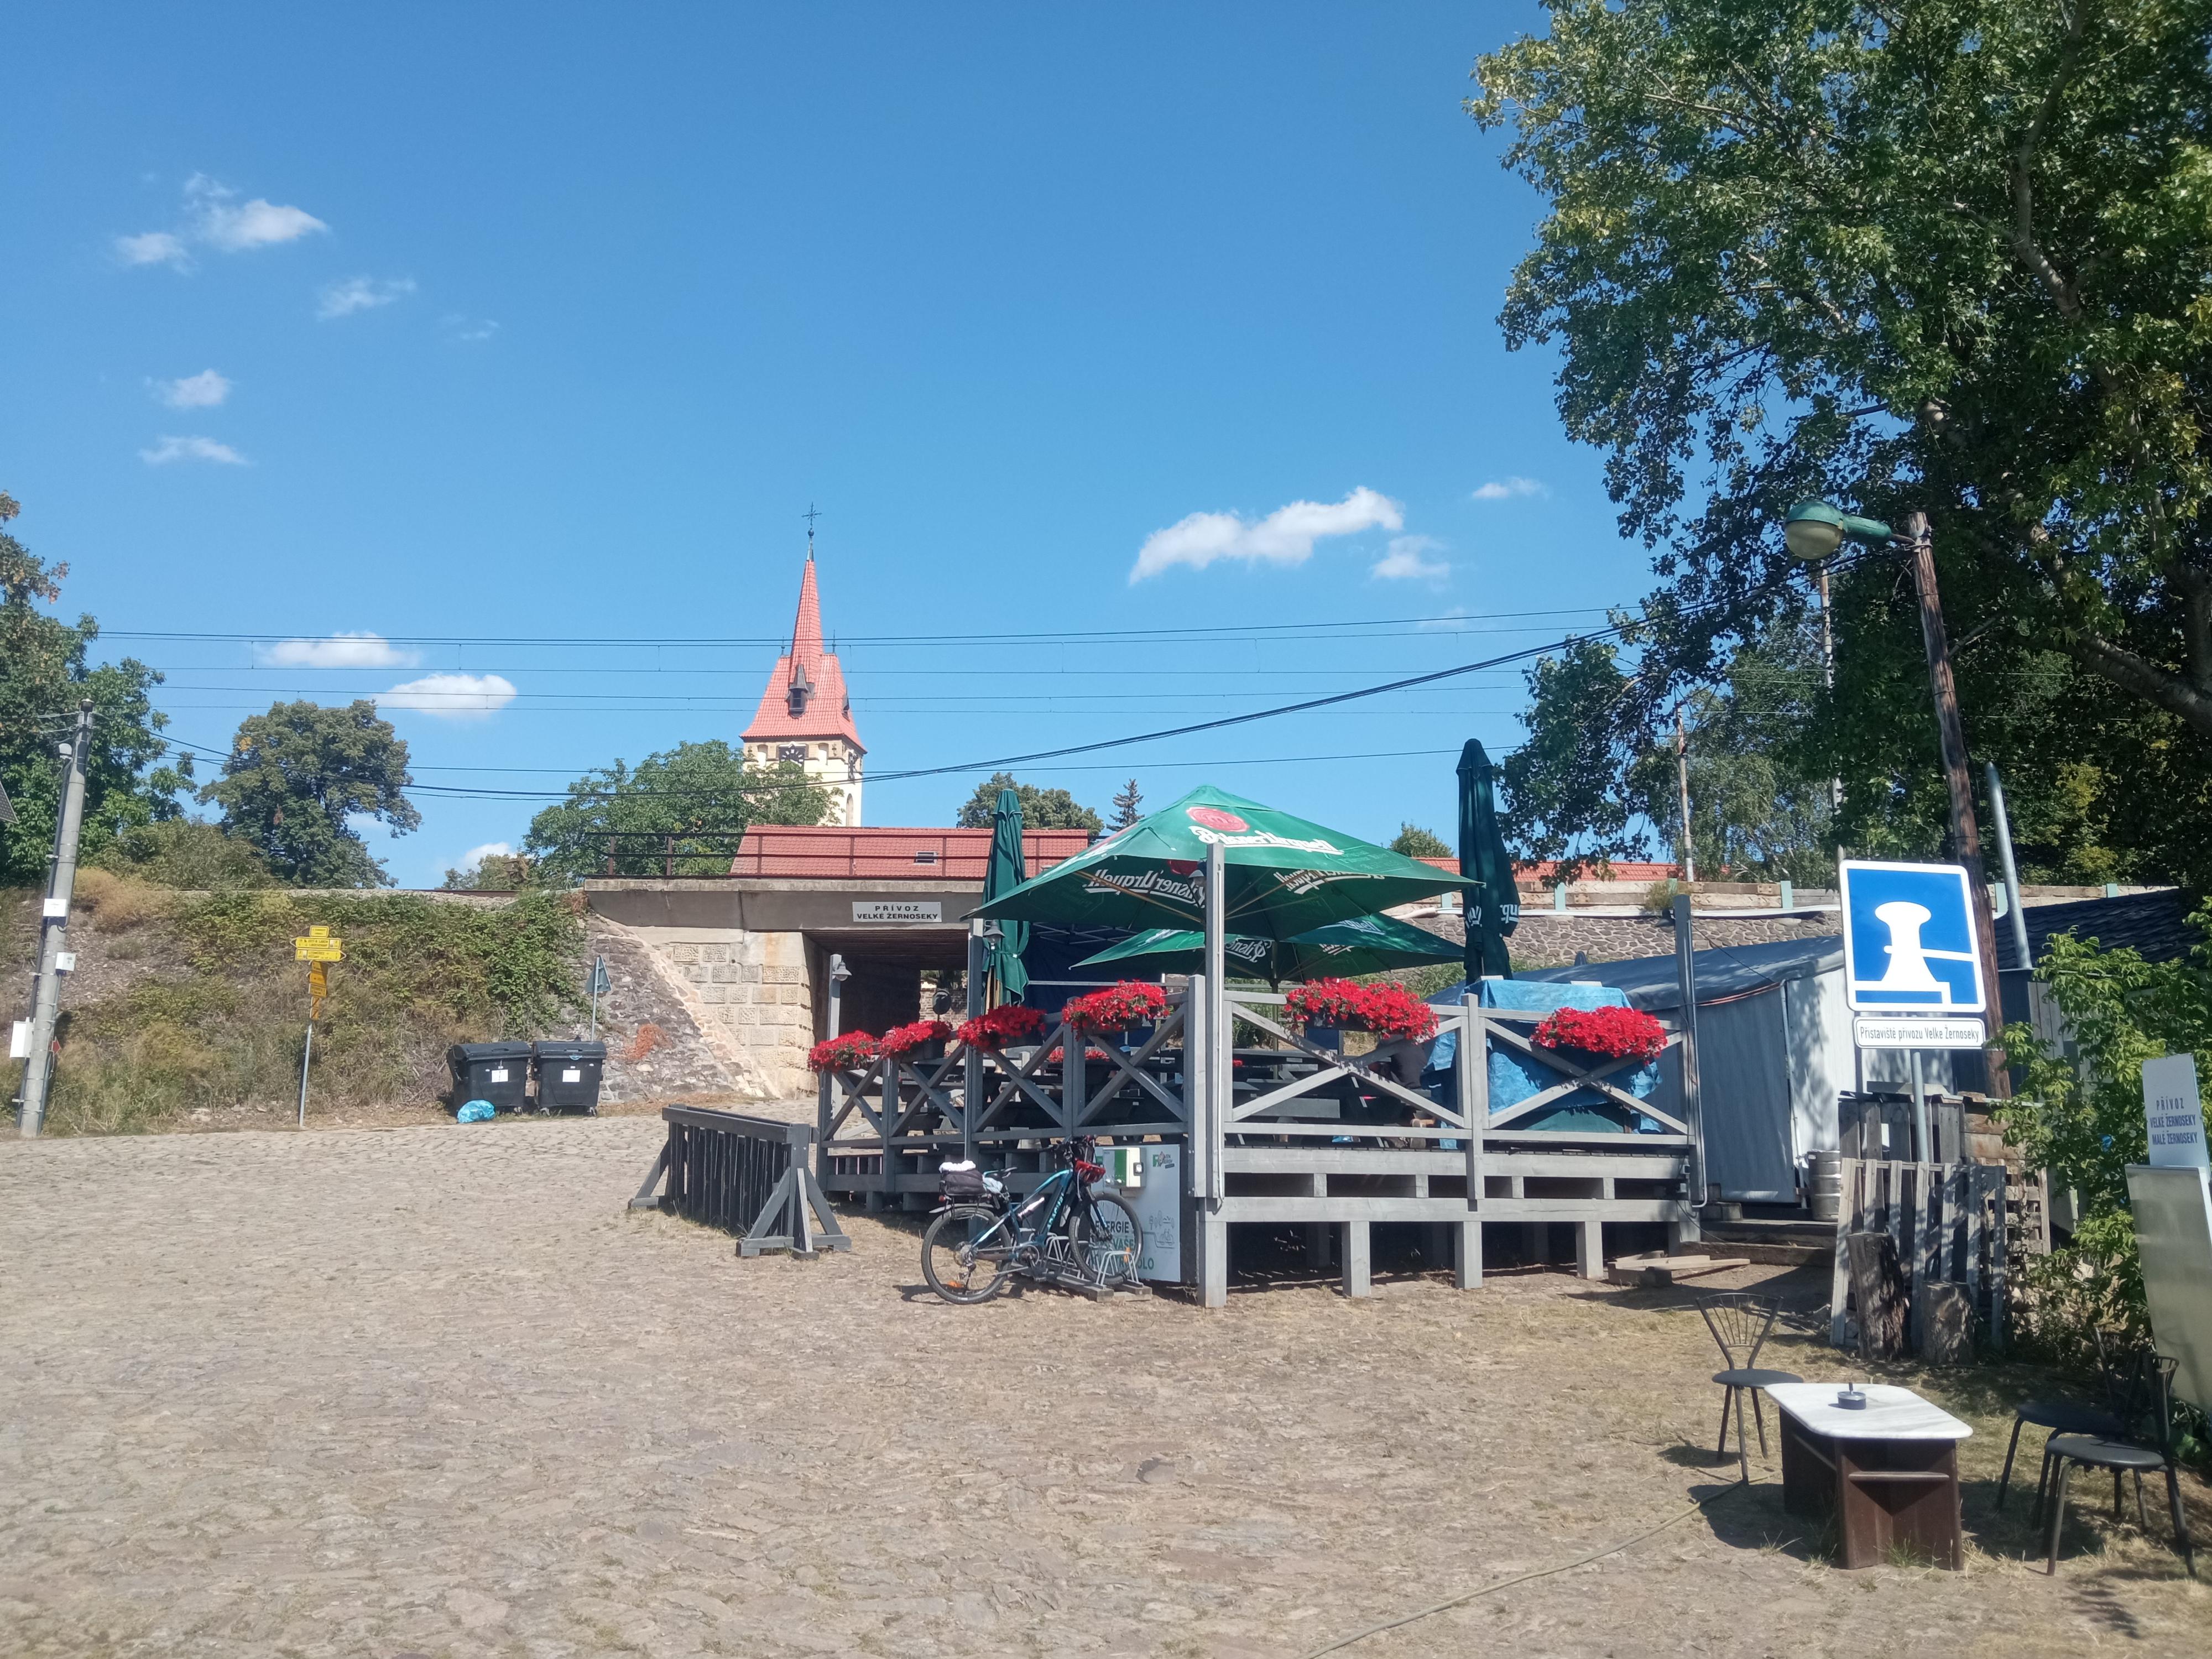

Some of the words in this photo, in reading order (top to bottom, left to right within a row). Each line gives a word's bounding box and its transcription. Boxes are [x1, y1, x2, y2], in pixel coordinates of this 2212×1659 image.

[1944, 1024, 1979, 1043] Žernoseky
[2156, 1095, 2184, 1110] PŘÍVOZ
[2150, 1113, 2164, 1128] VELKÉ
[2165, 1113, 2195, 1128] ŽERNOSEKY
[2152, 1130, 2166, 1145] MALÉ
[2167, 1130, 2198, 1145] ŽERNOSEKY
[1095, 1220, 1129, 1234] EERGIE
